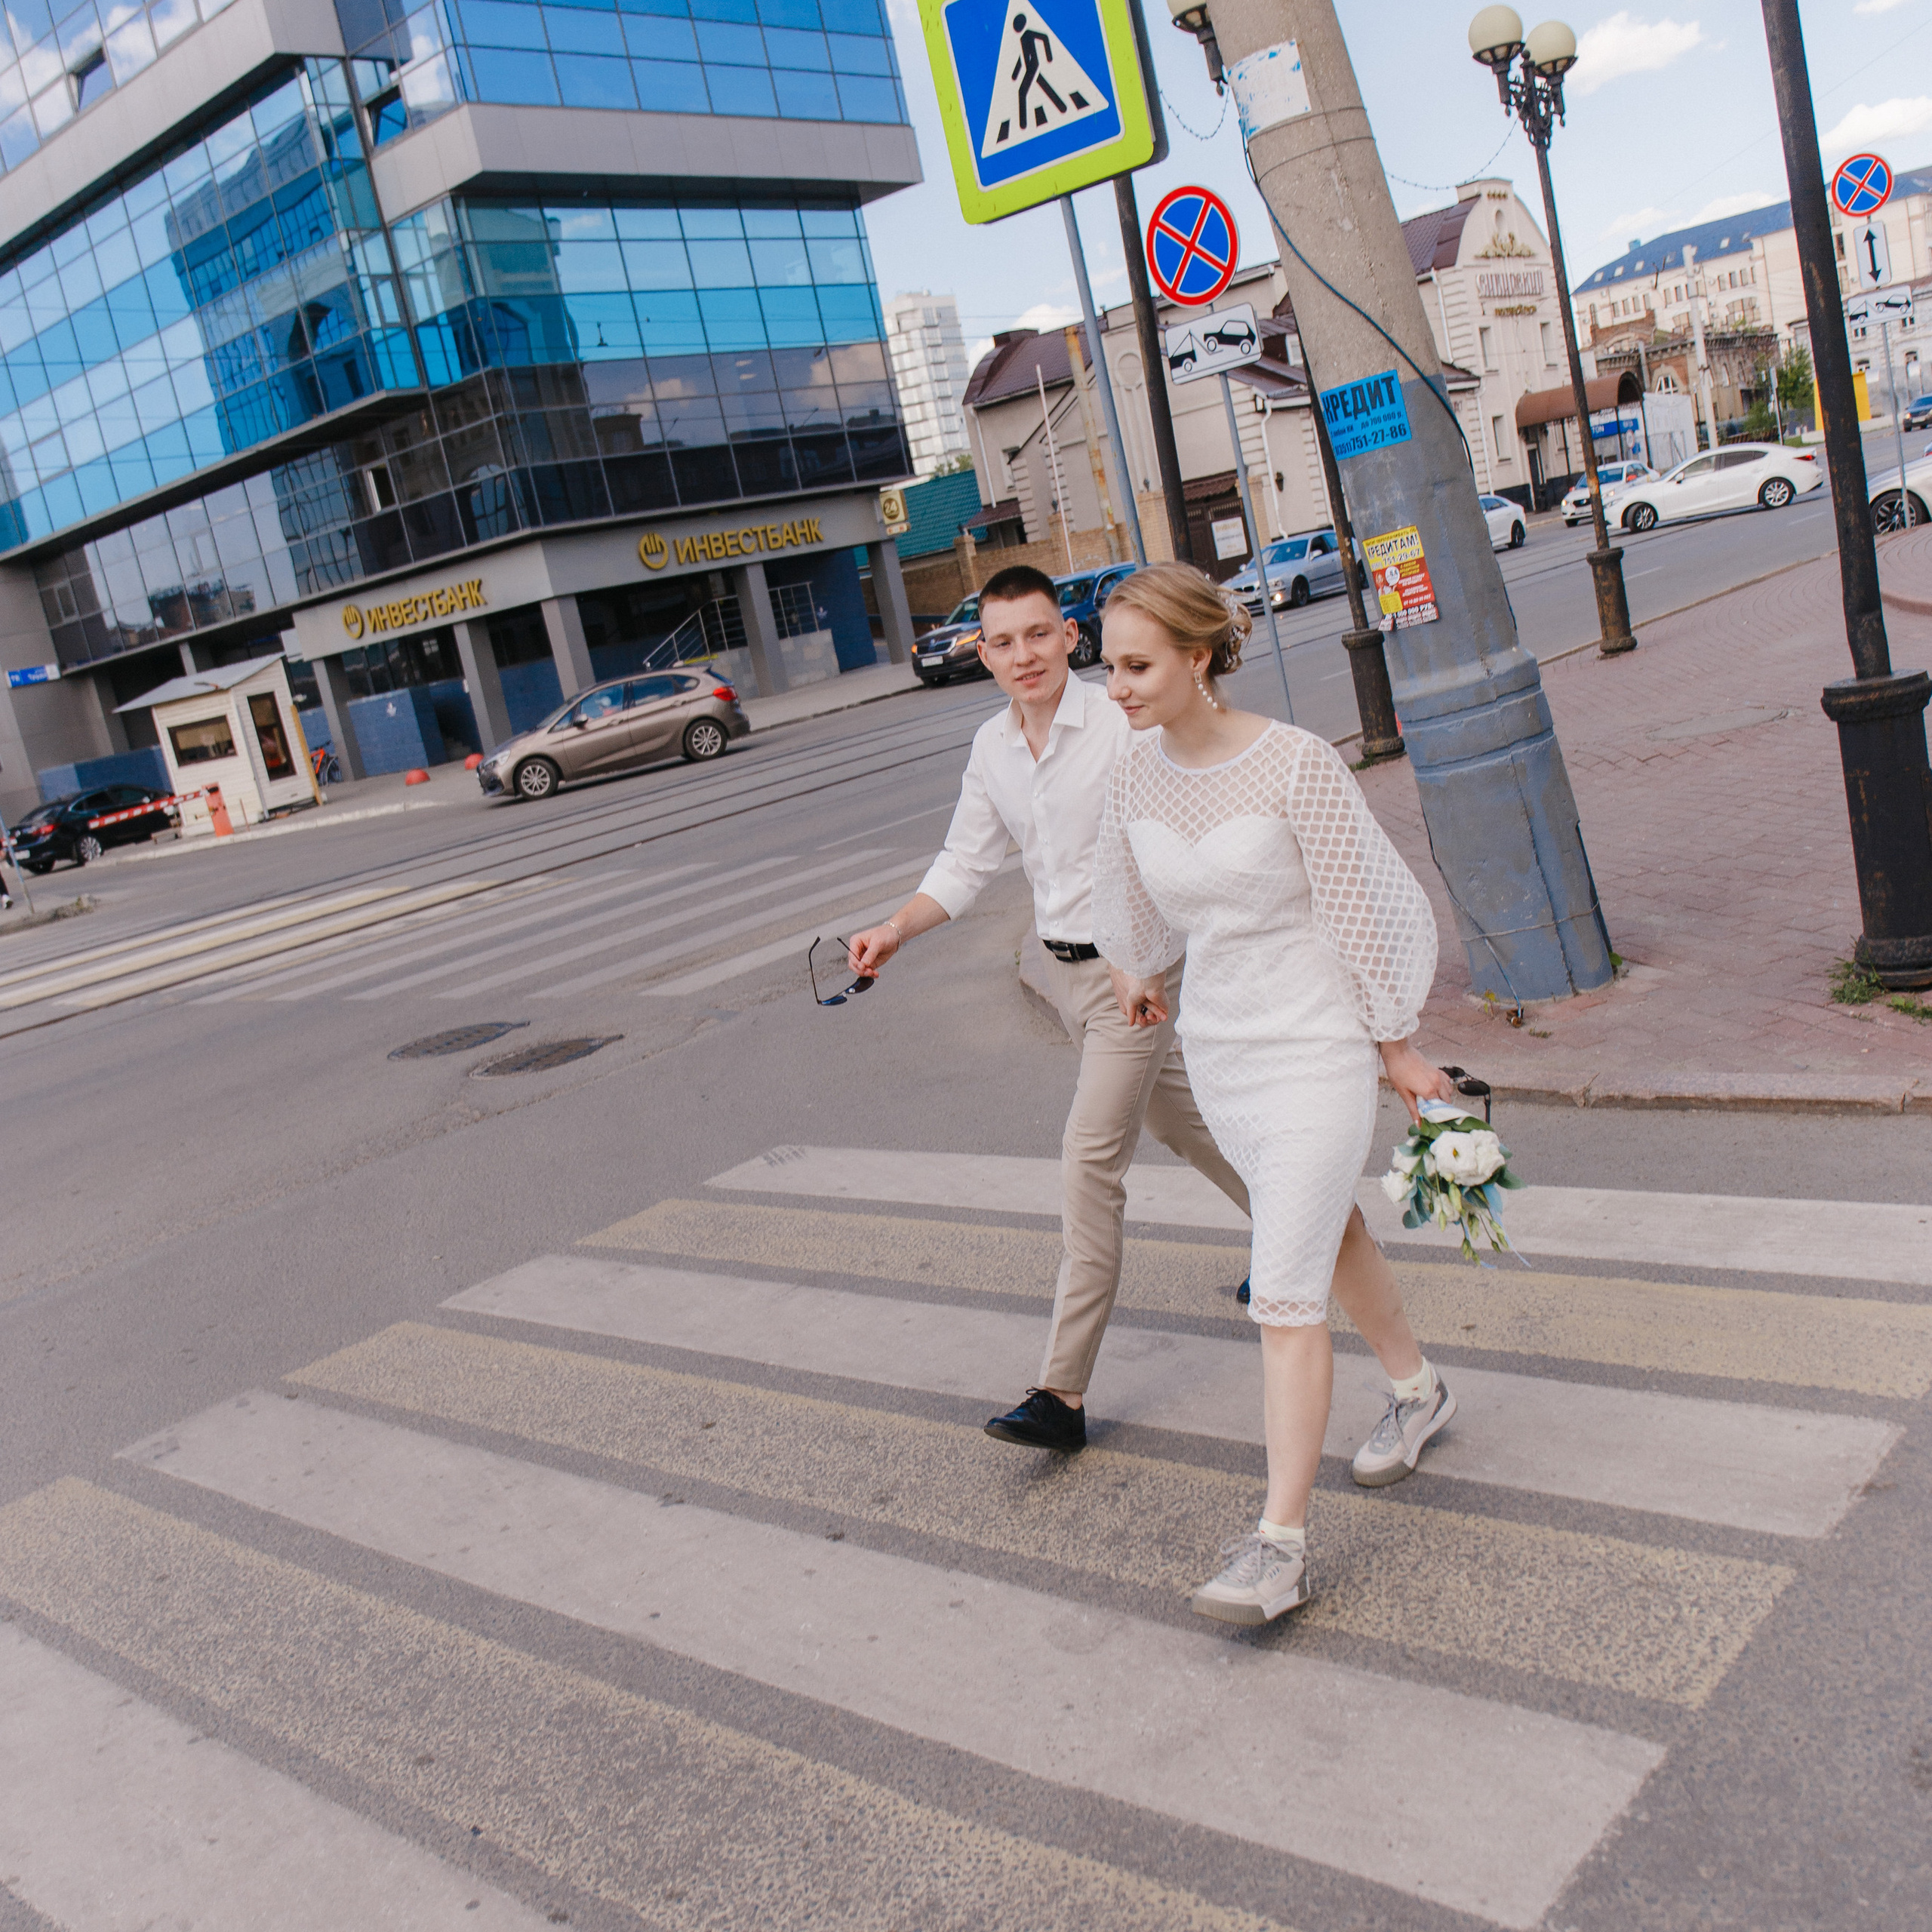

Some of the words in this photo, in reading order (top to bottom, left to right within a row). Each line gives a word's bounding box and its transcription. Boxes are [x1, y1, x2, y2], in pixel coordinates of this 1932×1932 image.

[1322, 376, 1396, 424] КРЕДИТ
[1370, 416, 1382, 425] 700
[1383, 412, 1396, 421] 000
[674, 517, 824, 565] ИНВЕСТБАНК
[365, 578, 488, 632] ИНВЕСТБАНК
